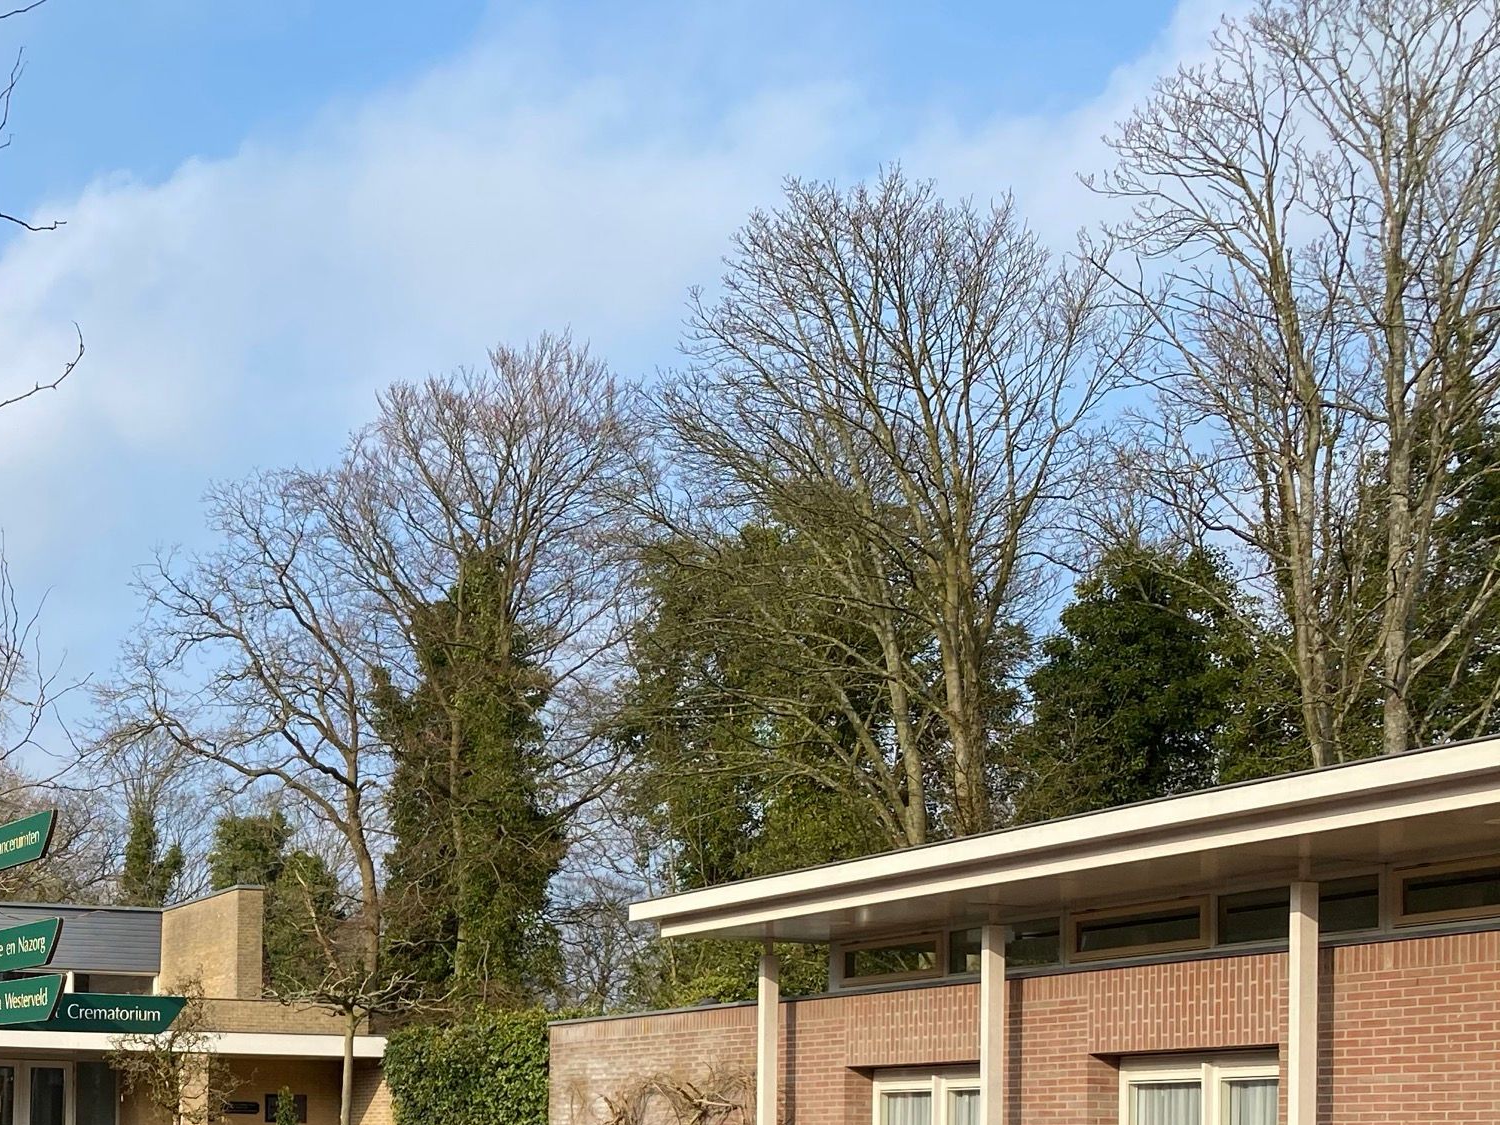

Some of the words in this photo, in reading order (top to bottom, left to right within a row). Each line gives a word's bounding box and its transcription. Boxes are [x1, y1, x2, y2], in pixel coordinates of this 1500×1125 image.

[6, 942, 16, 956] en
[18, 936, 46, 954] Nazorg
[4, 987, 48, 1010] Westerveld
[67, 1003, 161, 1021] Crematorium
